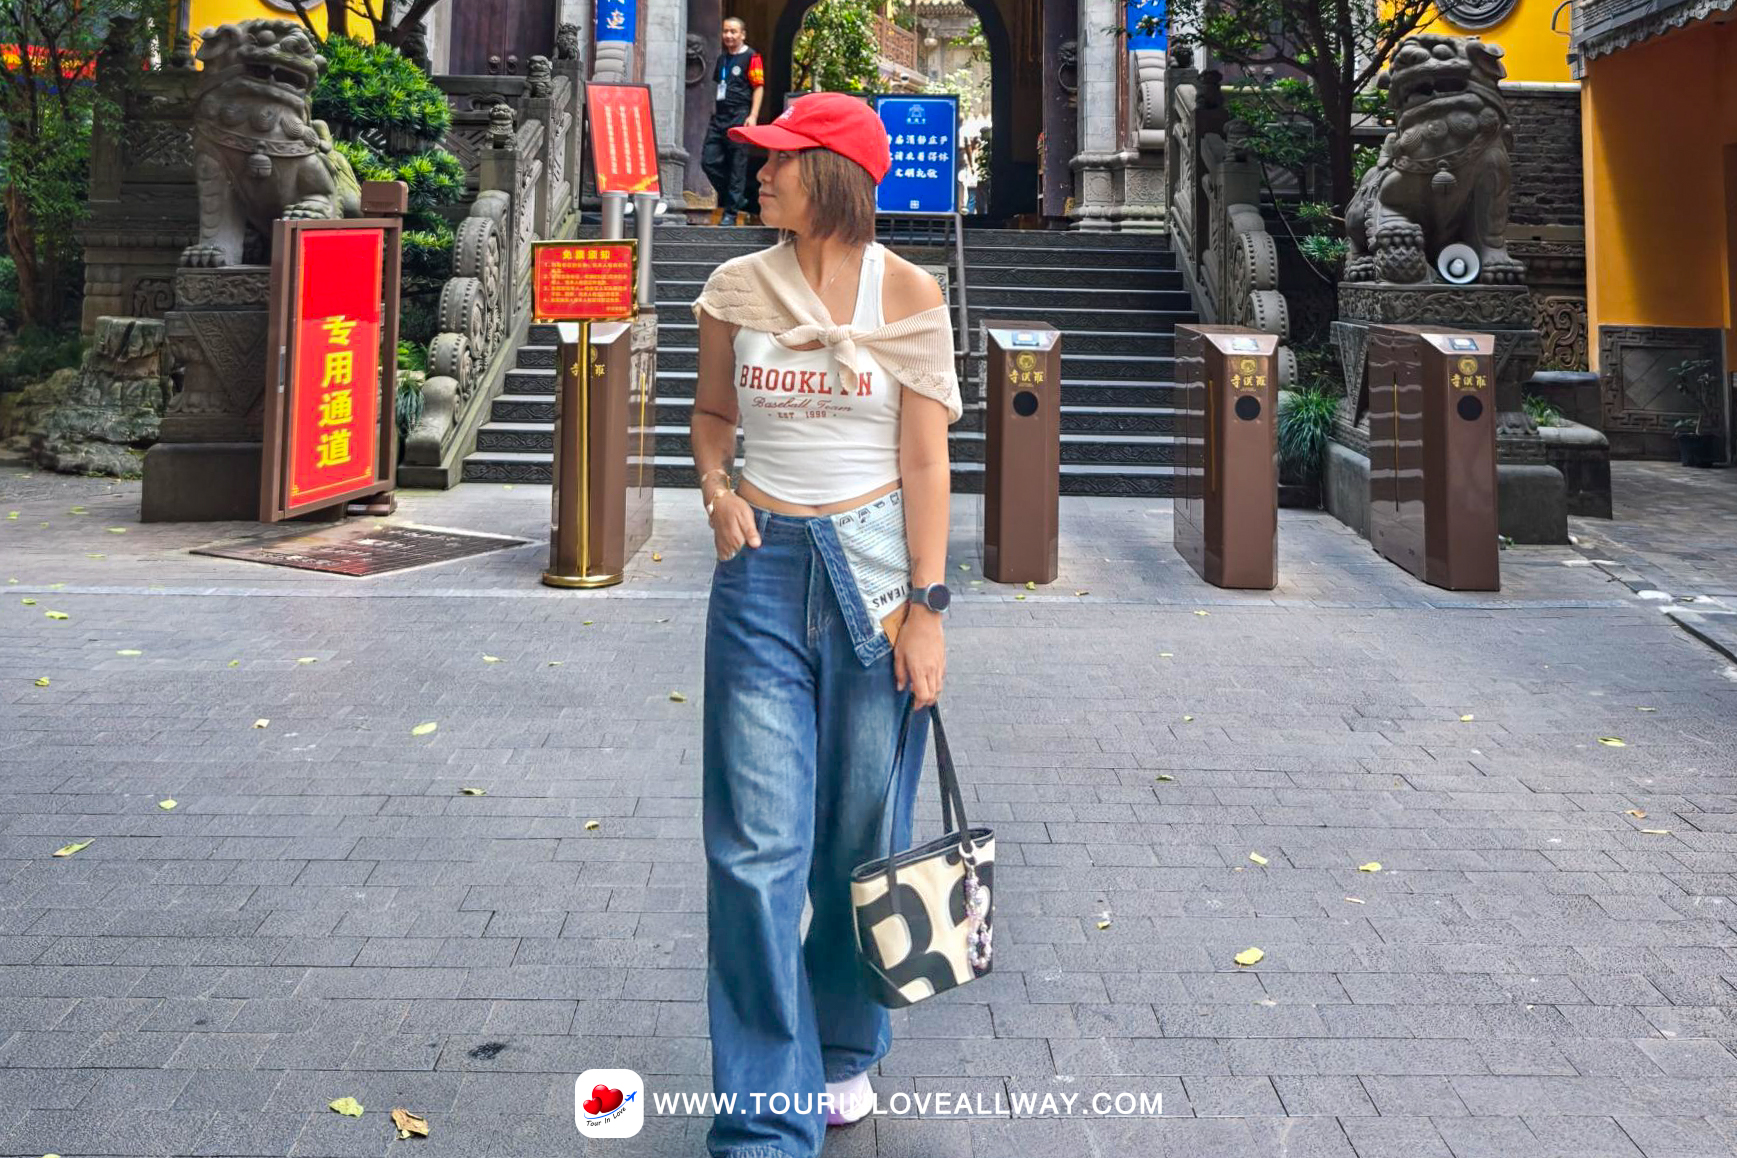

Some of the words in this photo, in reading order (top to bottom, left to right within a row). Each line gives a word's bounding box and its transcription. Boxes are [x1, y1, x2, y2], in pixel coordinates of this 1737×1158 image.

[889, 150, 950, 162] 请衣着得体
[316, 314, 357, 469] 专用通道
[739, 364, 873, 397] BROOKLN
[751, 396, 813, 409] Baseball
[816, 399, 854, 412] Team
